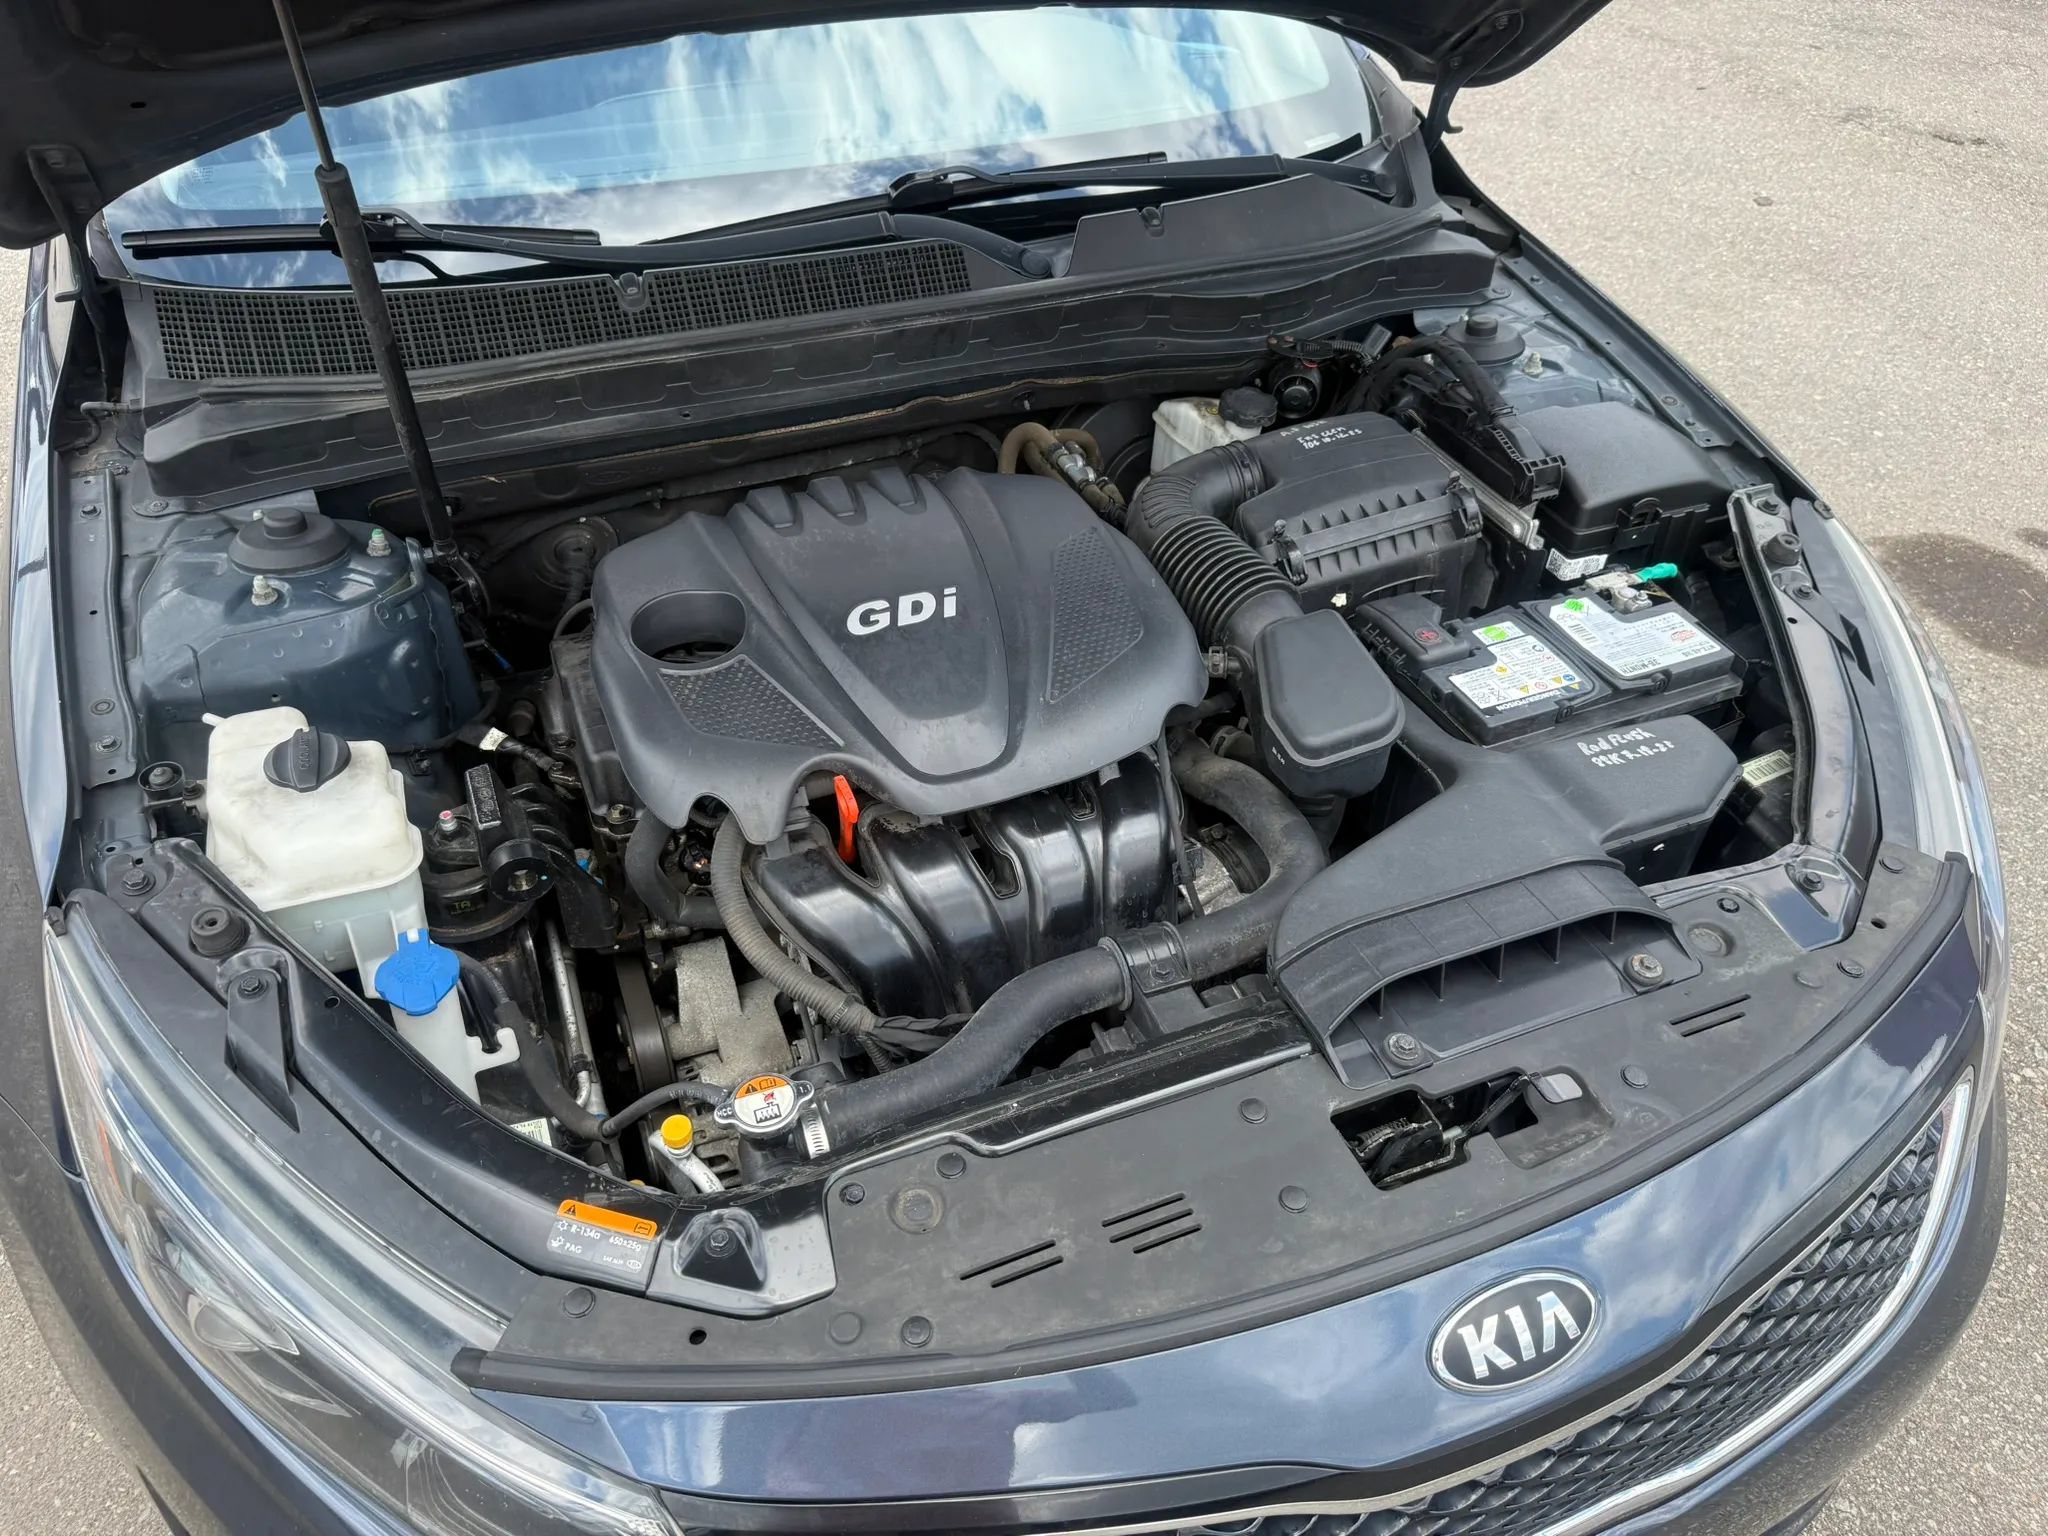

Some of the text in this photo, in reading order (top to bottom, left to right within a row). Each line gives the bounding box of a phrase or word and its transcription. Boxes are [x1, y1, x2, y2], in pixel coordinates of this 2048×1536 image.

[846, 586, 957, 636] GDi
[564, 1242, 582, 1254] PAG
[570, 1224, 601, 1240] R-134a
[1457, 1290, 1581, 1380] KIA
